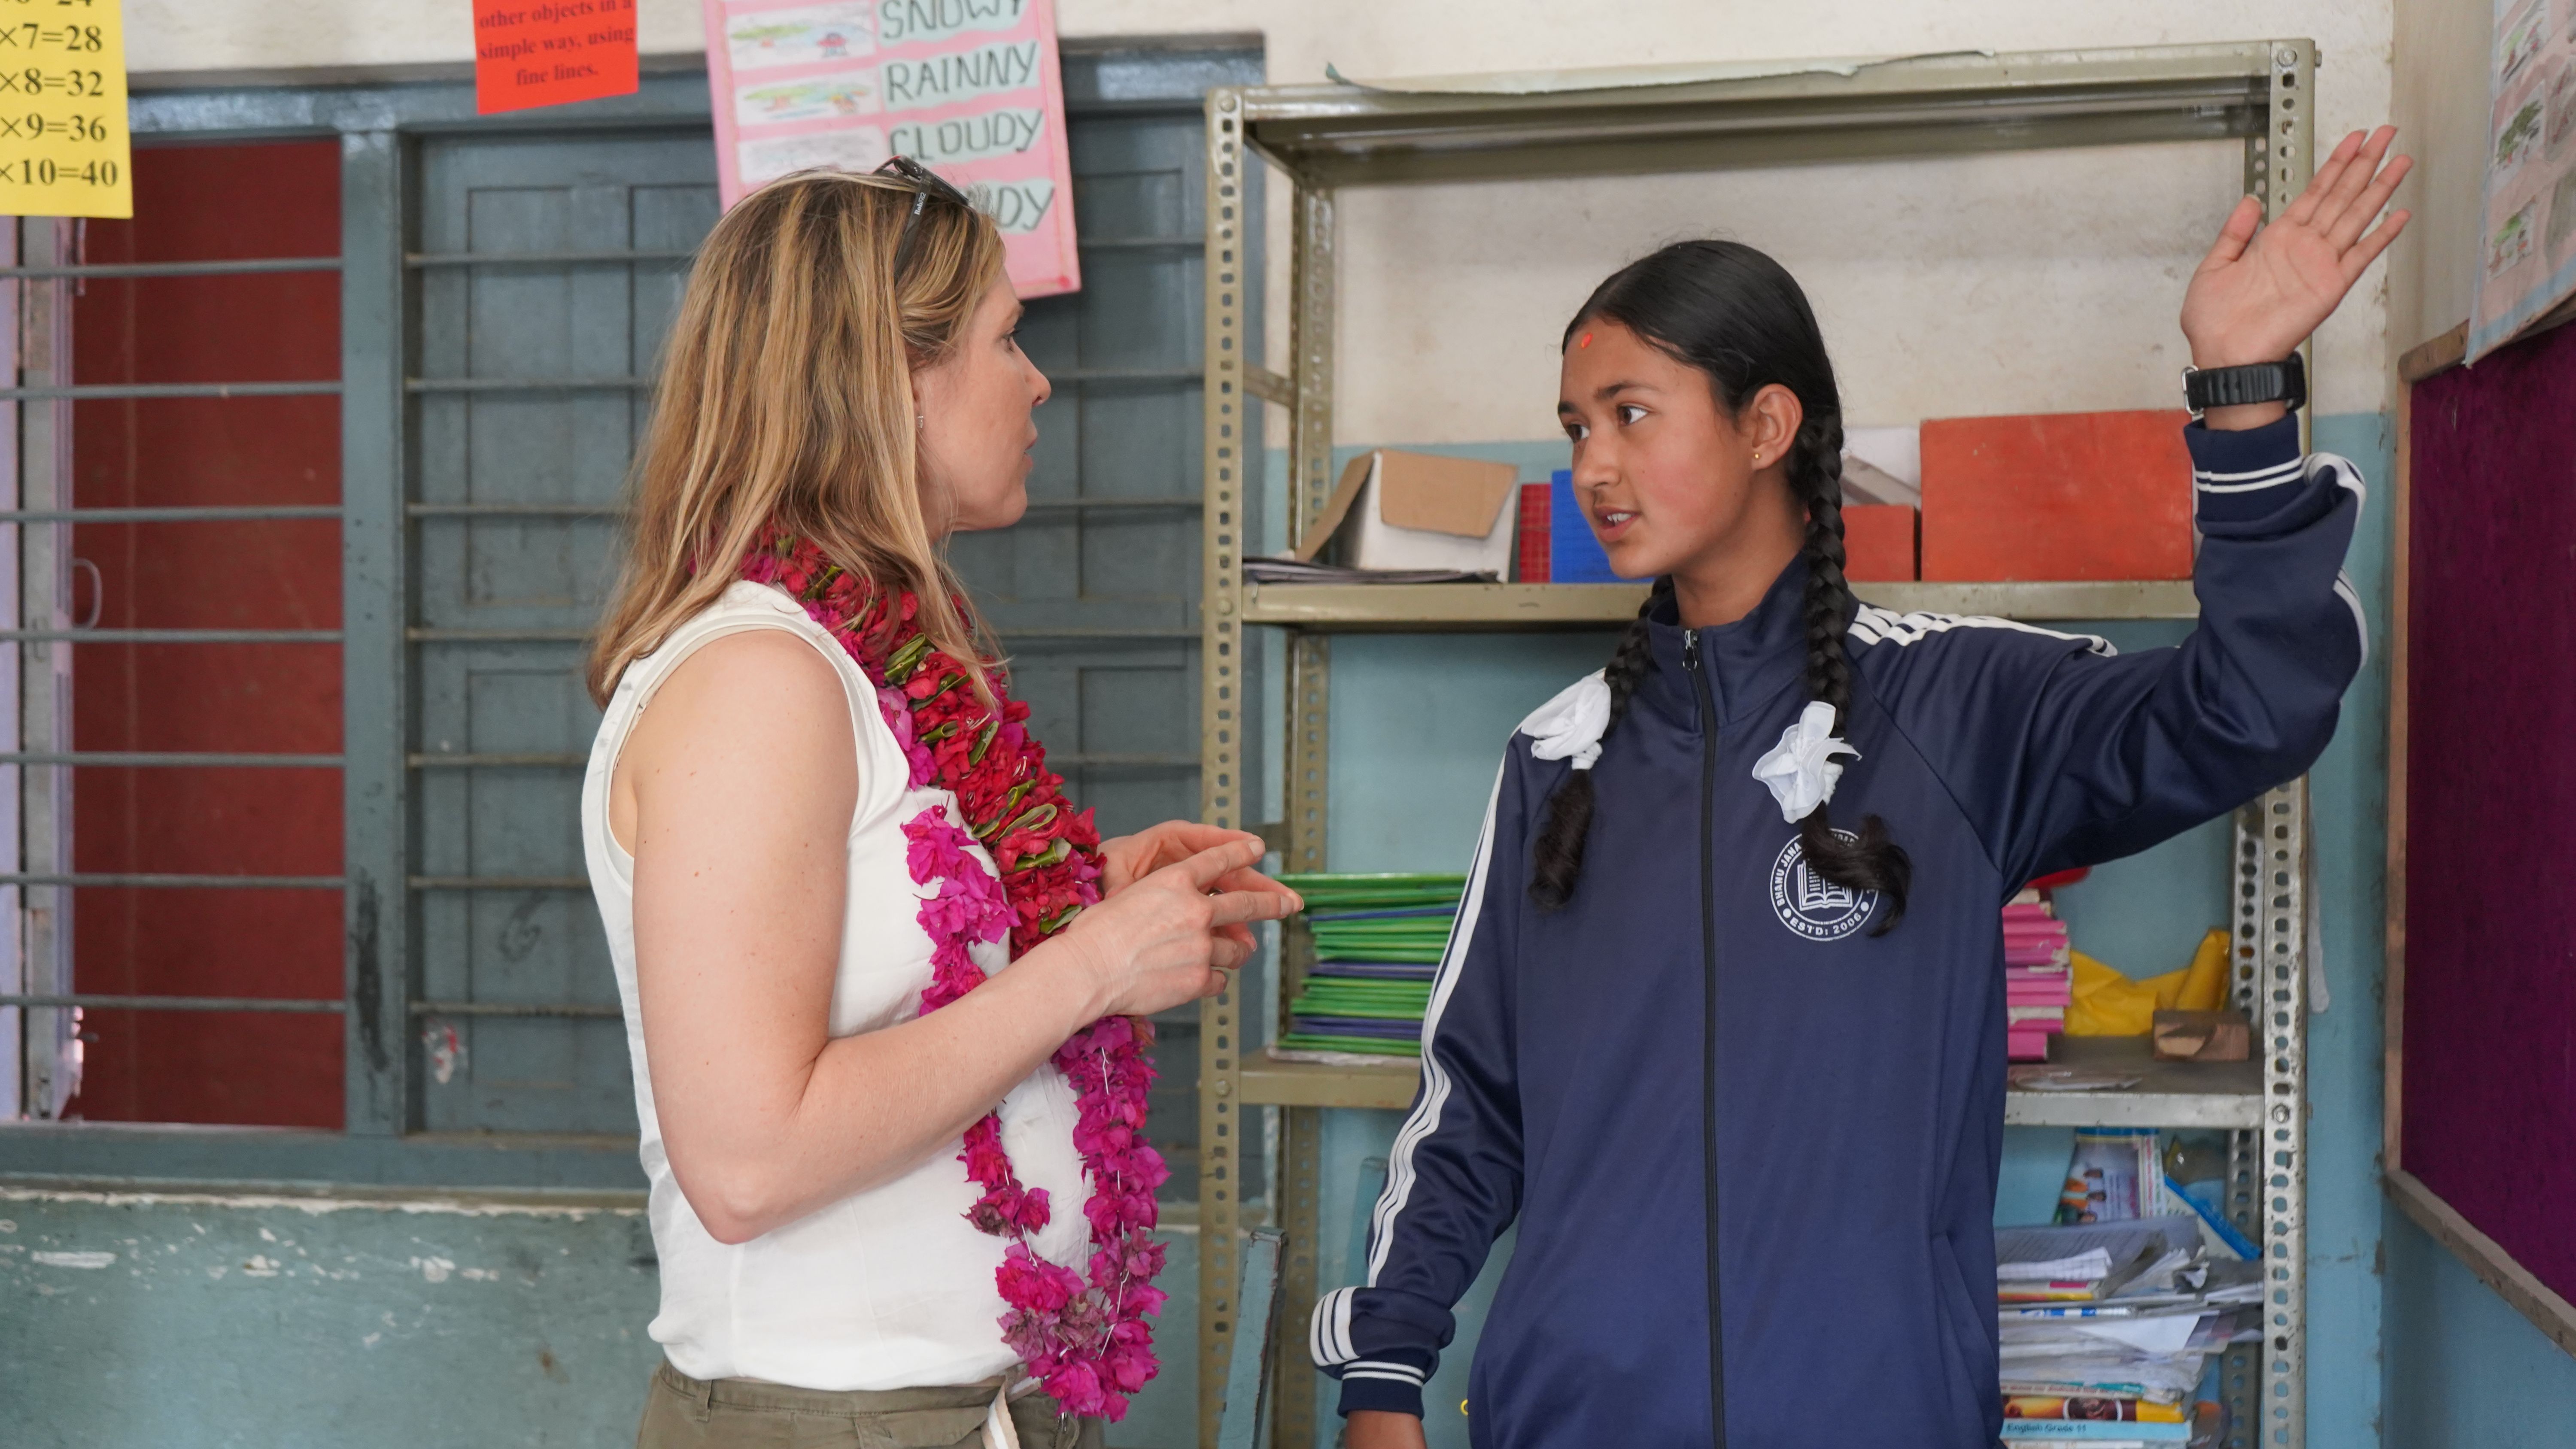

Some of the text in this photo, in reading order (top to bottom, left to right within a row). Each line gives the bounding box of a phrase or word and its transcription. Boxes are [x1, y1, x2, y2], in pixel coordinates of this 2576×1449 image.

[479, 10, 526, 28] other
[532, 1, 594, 24] objects
[600, 0, 617, 12] in
[480, 26, 635, 61] simple way, using
[516, 63, 598, 86] fine lines.
[887, 39, 1038, 103] RAINNY
[0, 112, 107, 142] ×9=36
[889, 109, 1044, 161] CLOUDY
[1774, 868, 1785, 907] BHANU
[1789, 912, 1862, 936] ESTD: 2006
[2007, 1422, 2043, 1435] English
